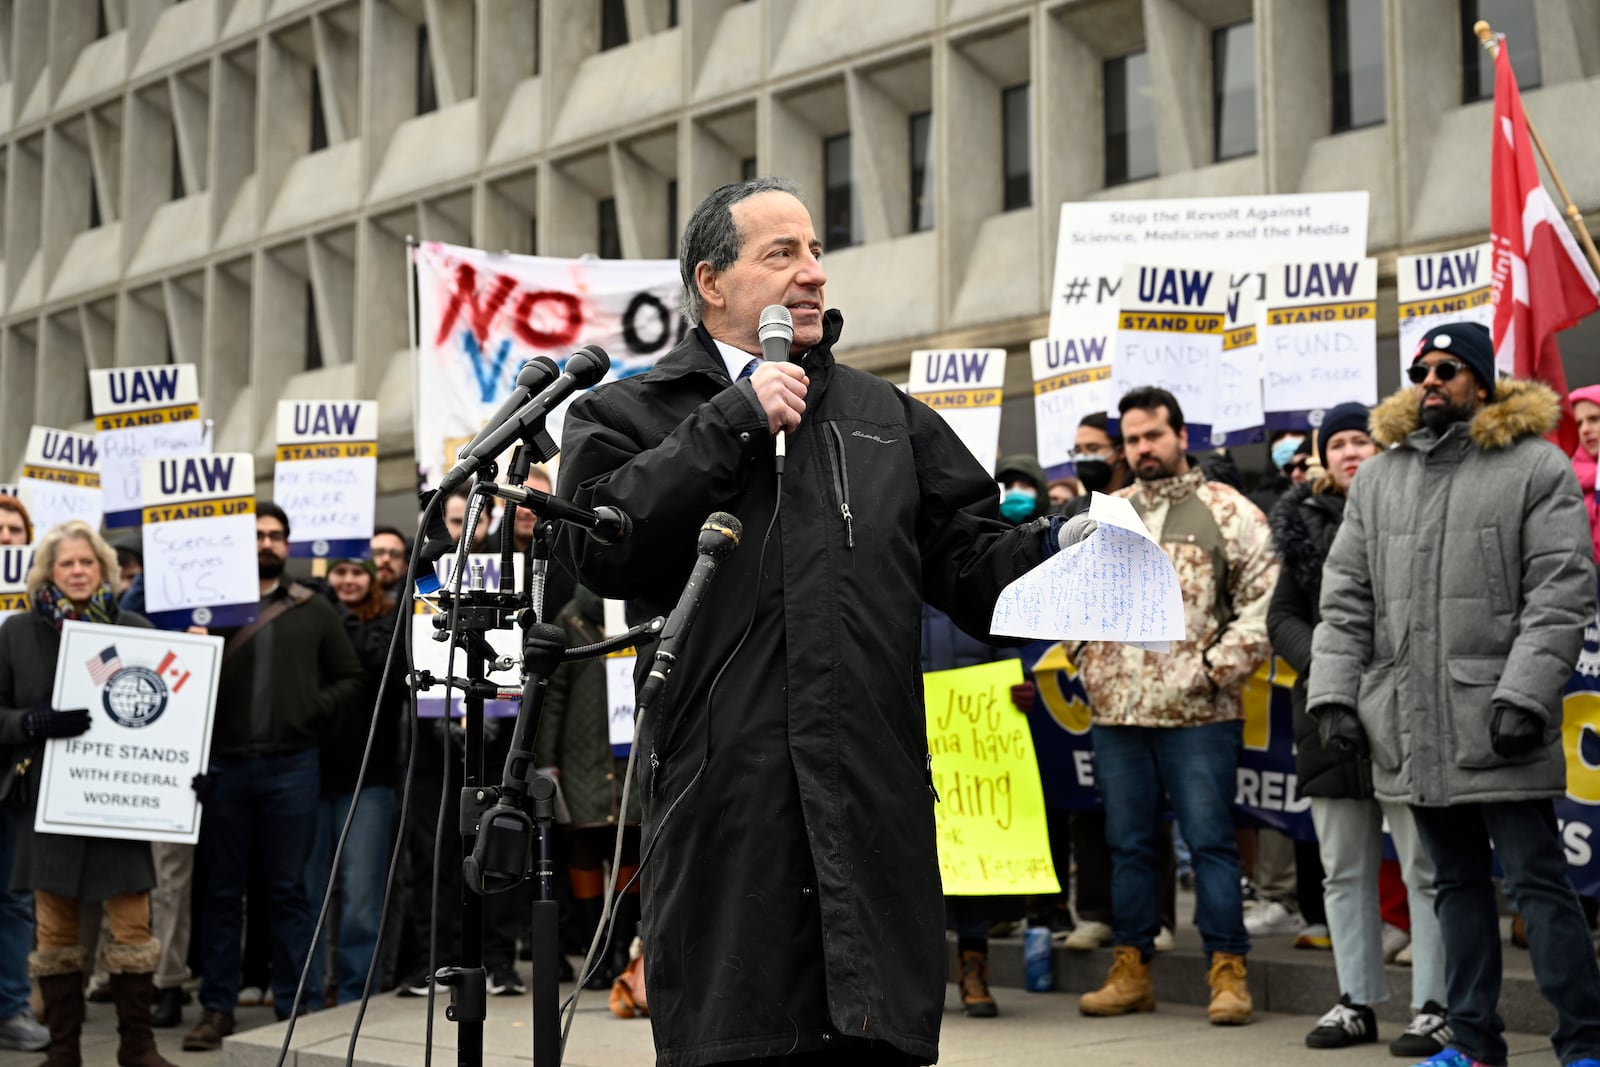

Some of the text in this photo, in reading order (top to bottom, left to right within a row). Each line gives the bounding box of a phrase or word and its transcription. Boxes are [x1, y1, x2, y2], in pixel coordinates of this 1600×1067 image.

[1110, 205, 1312, 226] Stop the Revolt Against
[1072, 223, 1350, 245] Science, Medicine and the Media
[1284, 262, 1358, 299] UAW
[1416, 250, 1480, 291] UAW
[1139, 266, 1213, 307] UAW
[437, 262, 583, 348] NO
[1272, 305, 1370, 325] STAND UP
[1406, 291, 1491, 318] STAND UP
[1123, 316, 1219, 331] STAND UP
[1046, 336, 1107, 369] UAW
[926, 353, 989, 383] UAW
[109, 368, 179, 405] UAW
[1040, 373, 1090, 394] STAND
[923, 393, 996, 407] TAND UP
[102, 409, 194, 430] STAND UP
[294, 404, 361, 435] UAW
[42, 431, 98, 467] UAW
[282, 445, 371, 461] STAND UP
[28, 470, 79, 485] STAND
[160, 456, 234, 495] UAW
[149, 500, 248, 523] STAND UP
[162, 571, 226, 606] U.S.
[937, 685, 1001, 732] Just
[65, 738, 190, 765] IFPTE STANDS
[972, 727, 1025, 764] have
[69, 767, 179, 788] WITH FEDERAL
[83, 791, 160, 809] WORKERS
